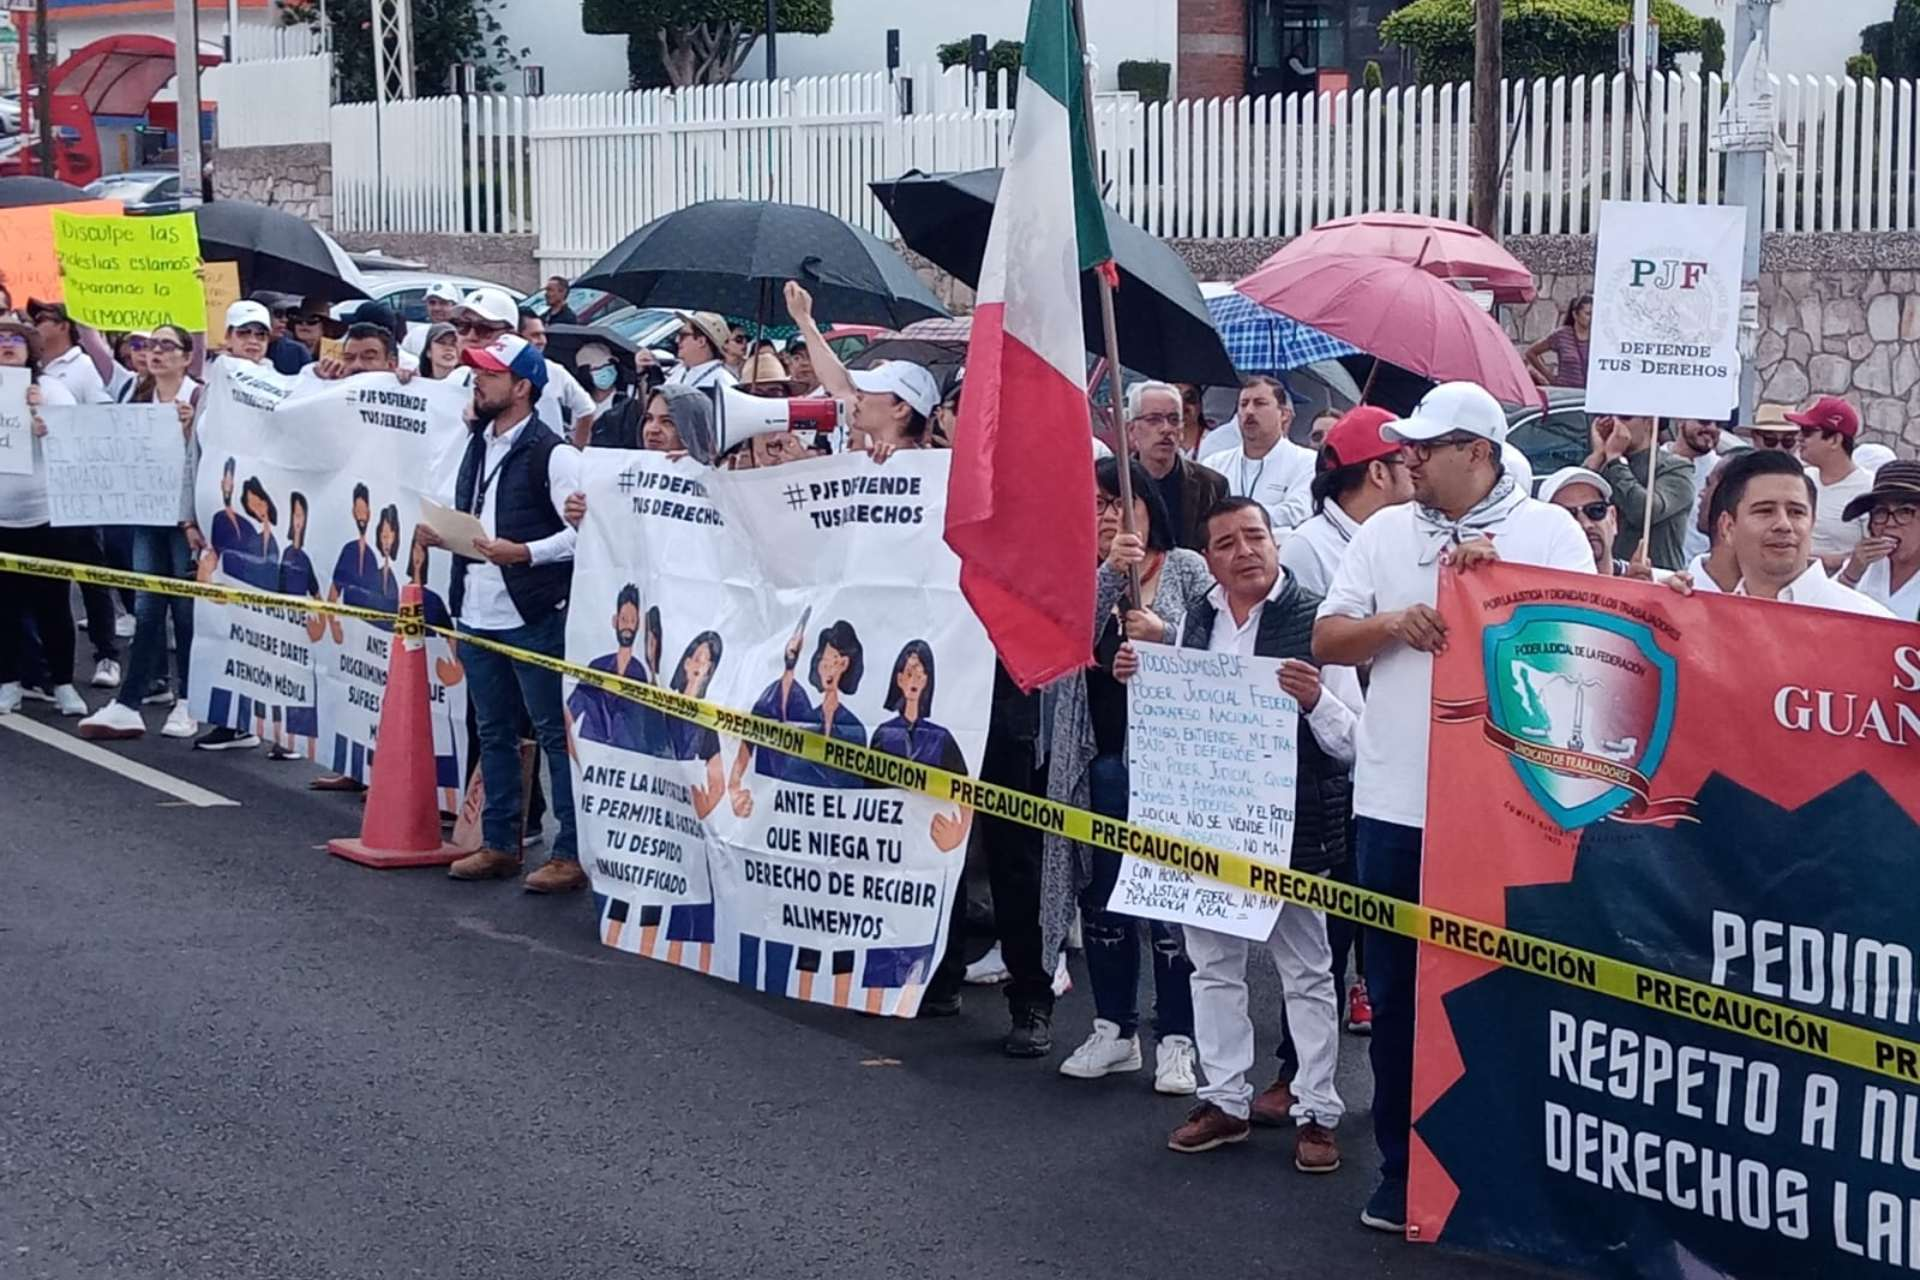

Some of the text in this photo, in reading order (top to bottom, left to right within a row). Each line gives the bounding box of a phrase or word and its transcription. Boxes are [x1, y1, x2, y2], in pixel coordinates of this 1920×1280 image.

[62, 220, 180, 246] Disculpe las
[1630, 259, 1708, 290] PJF
[1598, 358, 1631, 372] TUS
[1620, 342, 1711, 358] DEFIENDE
[810, 508, 840, 529] TUS
[583, 764, 626, 788] ANTE
[630, 773, 648, 792] LA
[774, 789, 904, 826] ANTE EL JUEZ
[607, 830, 682, 864] TU DESPIDO
[767, 827, 901, 864] QUE NIEGA TU
[744, 859, 936, 908] DERECHO DE RECIBIR
[782, 903, 884, 940] ALIMENTOS
[950, 778, 1065, 832] PRECAUCIÓN
[1091, 819, 1220, 877] PRECAUCIÓN
[1250, 864, 1396, 927] PRECAUCIÓN
[1429, 914, 1597, 986] PRECAUCIÓN
[1636, 974, 1830, 1053] PRECAUCIÓN
[1710, 909, 1920, 1025] PEDIM
[1549, 1009, 1780, 1136] RESPETO
[1801, 1073, 1839, 1151] A
[1545, 1100, 1810, 1240] DERECHOS
